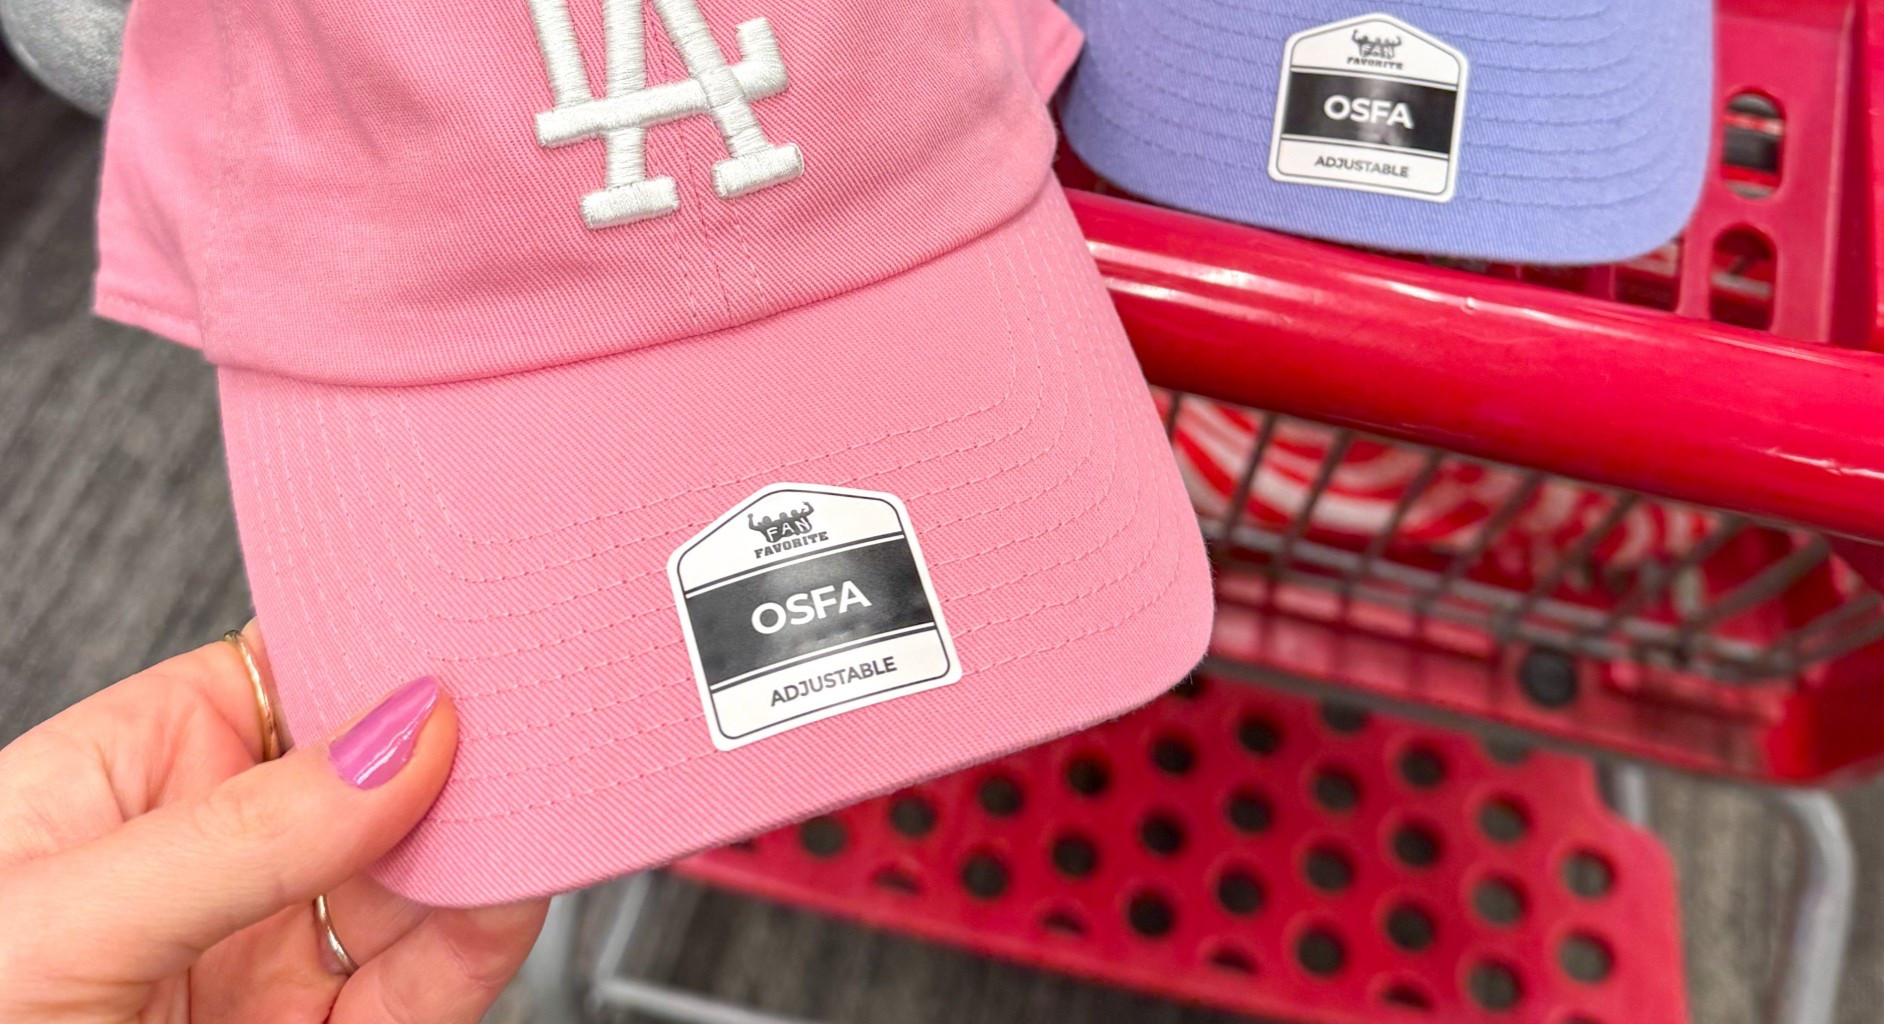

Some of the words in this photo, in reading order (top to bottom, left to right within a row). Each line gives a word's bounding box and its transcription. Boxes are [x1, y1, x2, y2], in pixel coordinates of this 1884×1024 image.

[1346, 56, 1404, 70] FAVORITE
[1323, 94, 1414, 129] OSFA
[1314, 155, 1409, 178] ADJUSTABLE
[766, 517, 812, 543] FAN
[754, 531, 829, 559] FAVORITE
[751, 580, 872, 635] OSFA
[770, 656, 898, 707] ADJUSTABLE
